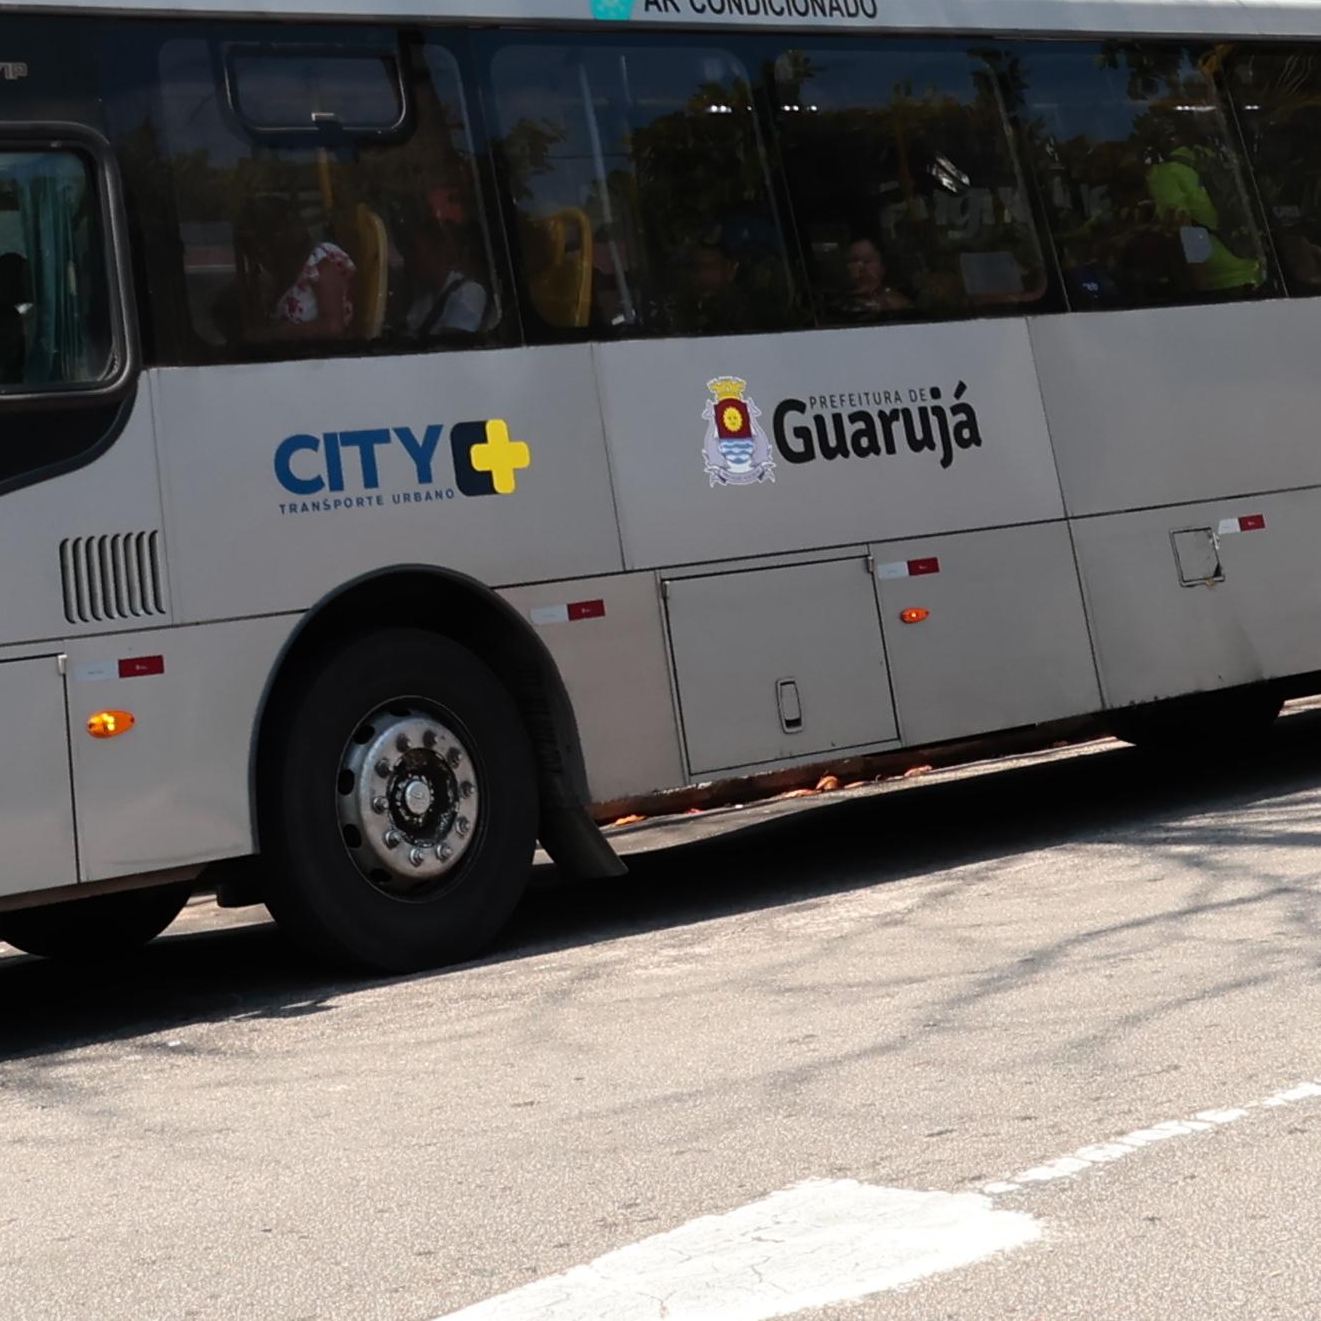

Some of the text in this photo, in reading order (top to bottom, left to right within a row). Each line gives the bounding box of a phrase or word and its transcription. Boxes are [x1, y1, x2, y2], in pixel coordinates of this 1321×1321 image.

[809, 387, 927, 410] PREFEITURA DE
[772, 380, 983, 469] Guarujá
[279, 488, 456, 515] TRANSPORTE URBANO
